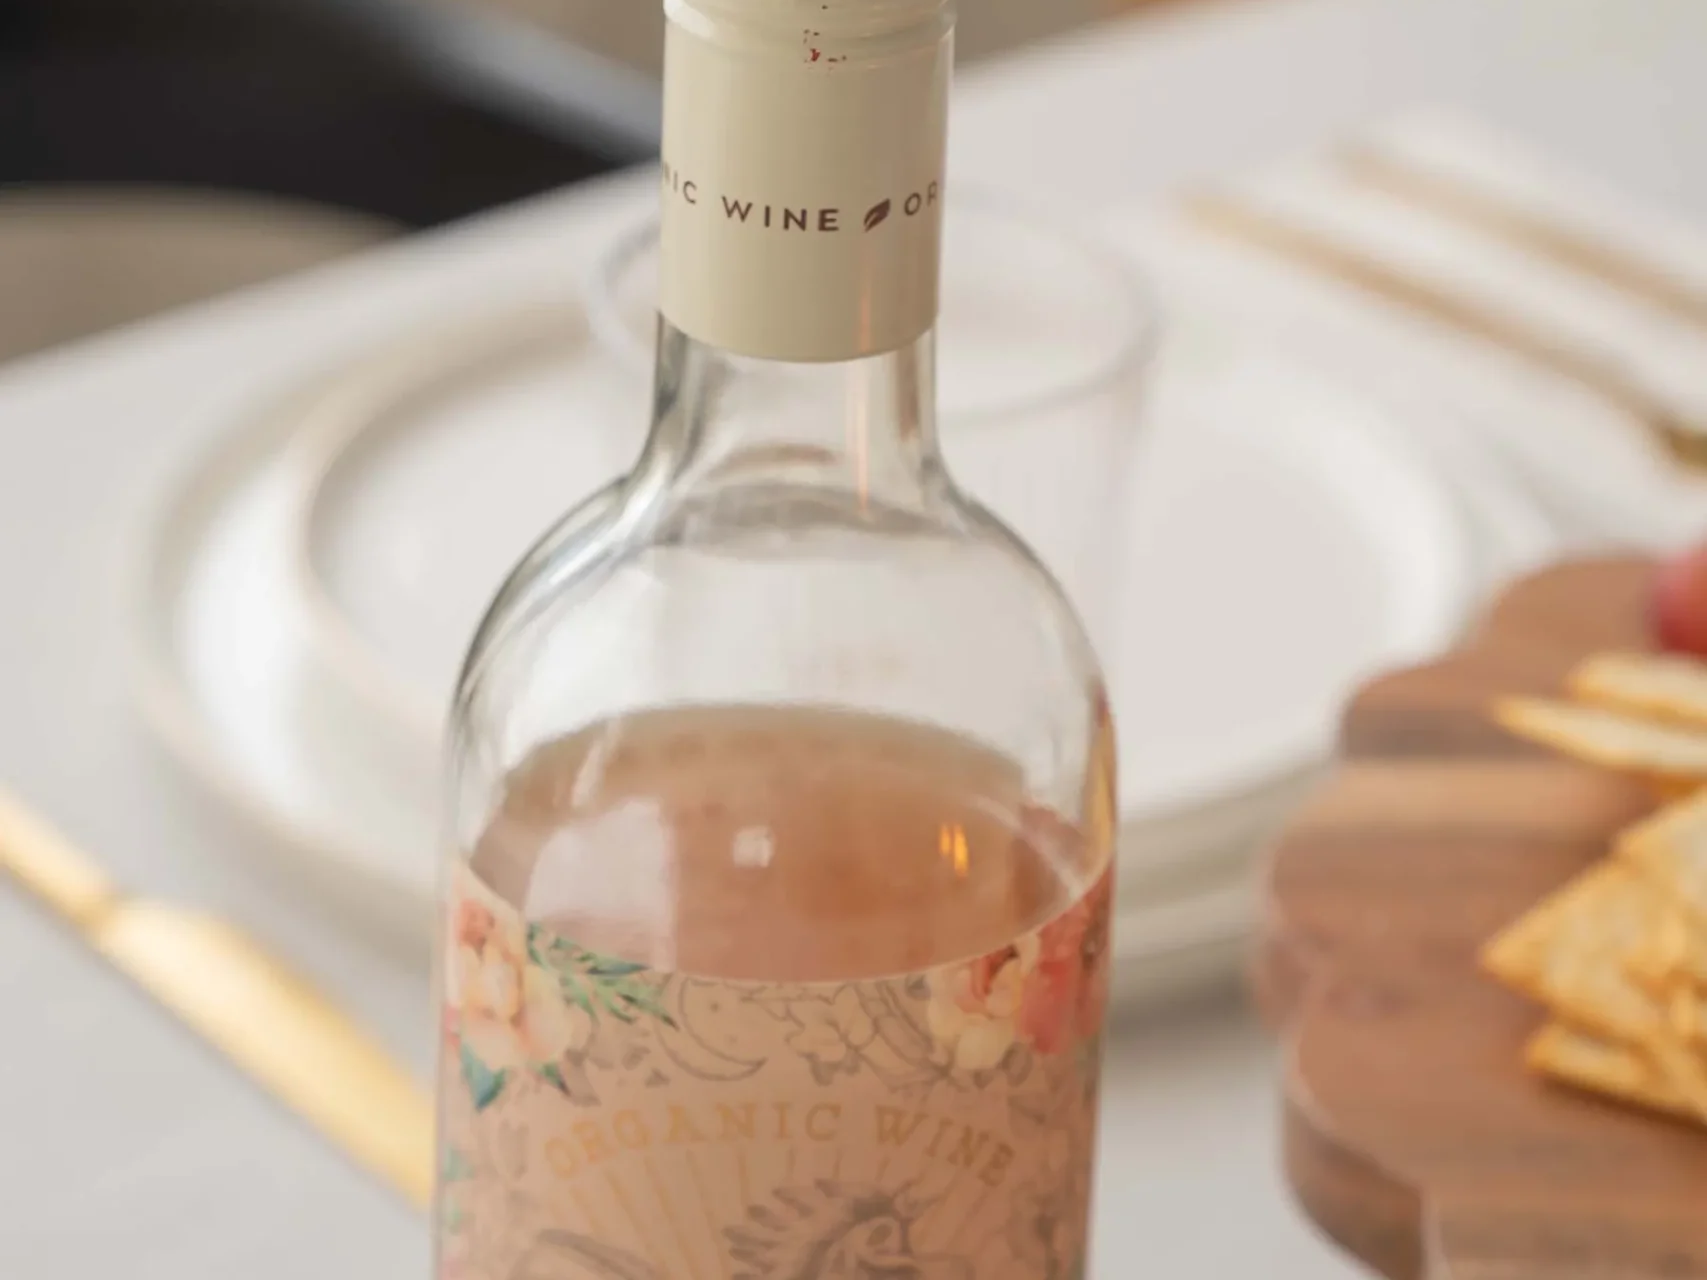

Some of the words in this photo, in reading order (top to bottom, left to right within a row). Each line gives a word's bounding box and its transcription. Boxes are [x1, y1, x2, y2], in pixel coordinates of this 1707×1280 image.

[722, 196, 839, 231] WINE
[544, 1102, 842, 1180] ORGANIC
[875, 1105, 1015, 1187] WINE
